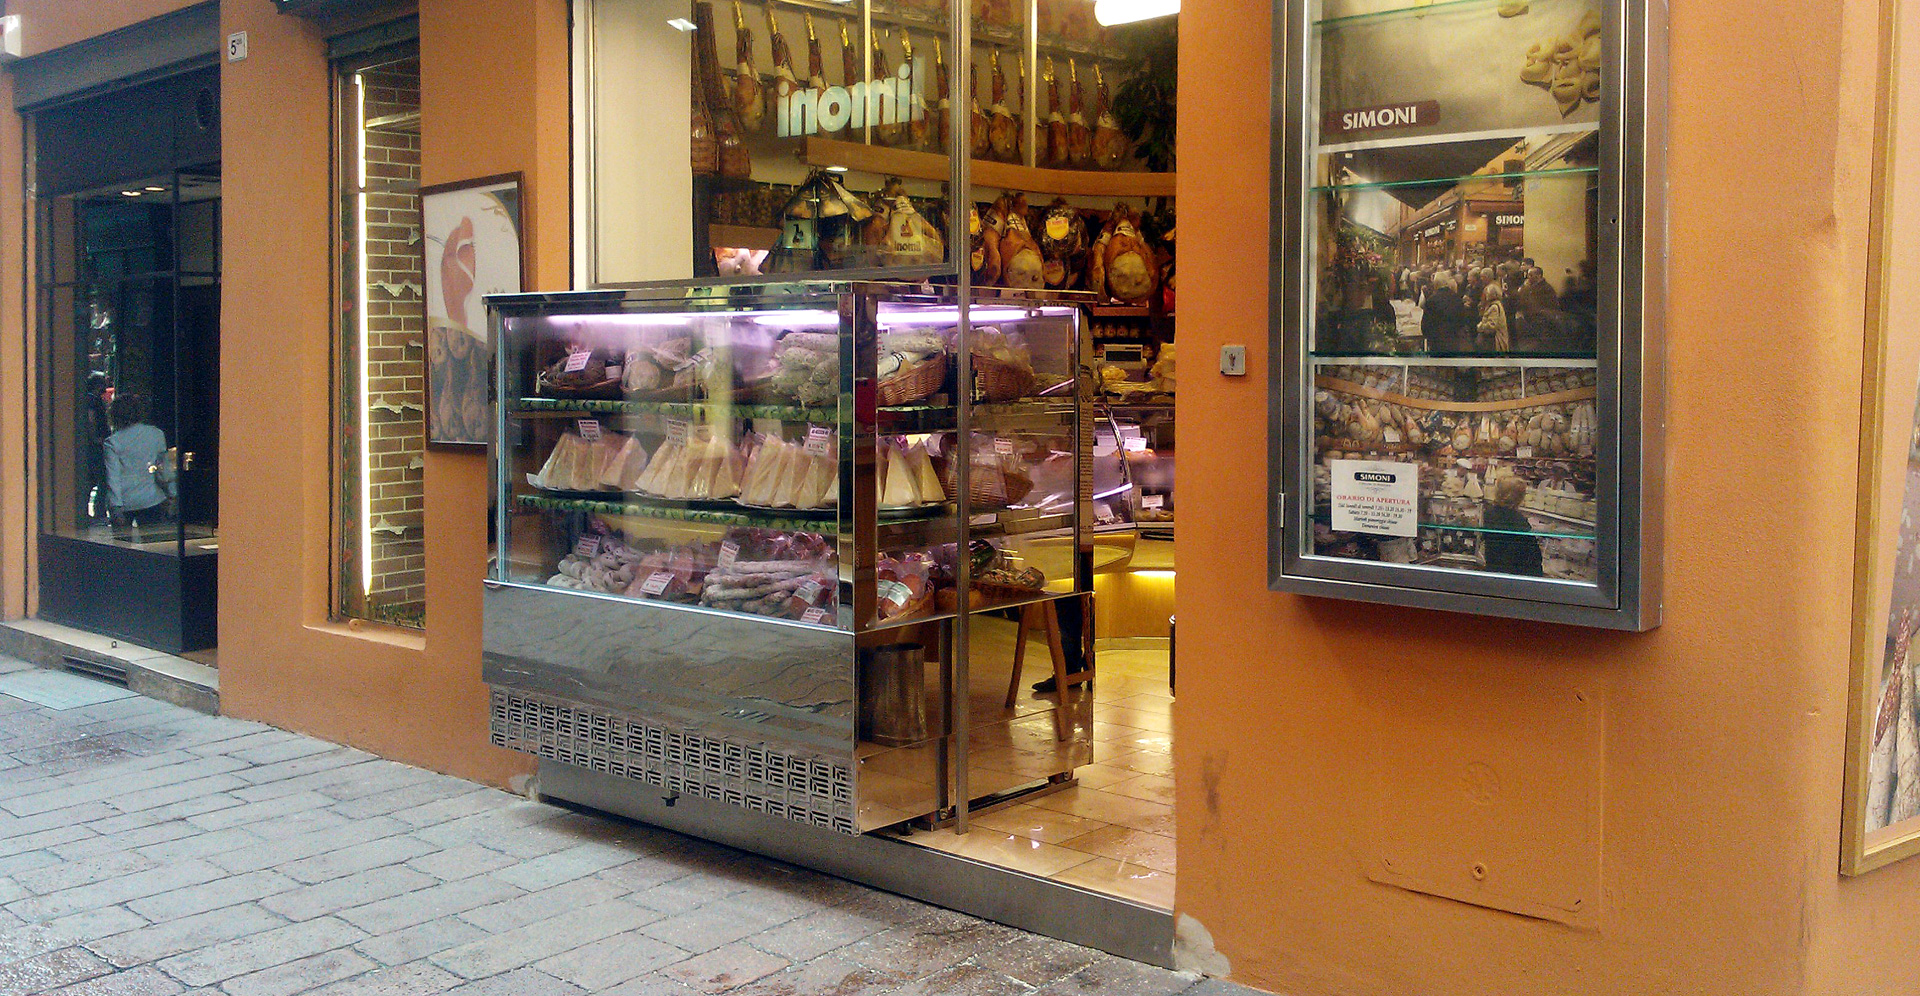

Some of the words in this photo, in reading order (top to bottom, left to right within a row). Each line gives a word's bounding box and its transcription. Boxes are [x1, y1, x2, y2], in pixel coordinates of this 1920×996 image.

[230, 40, 237, 56] 5
[1342, 106, 1417, 130] SIMONI
[1360, 474, 1391, 482] SIMONI
[1376, 498, 1411, 506] APERTURA
